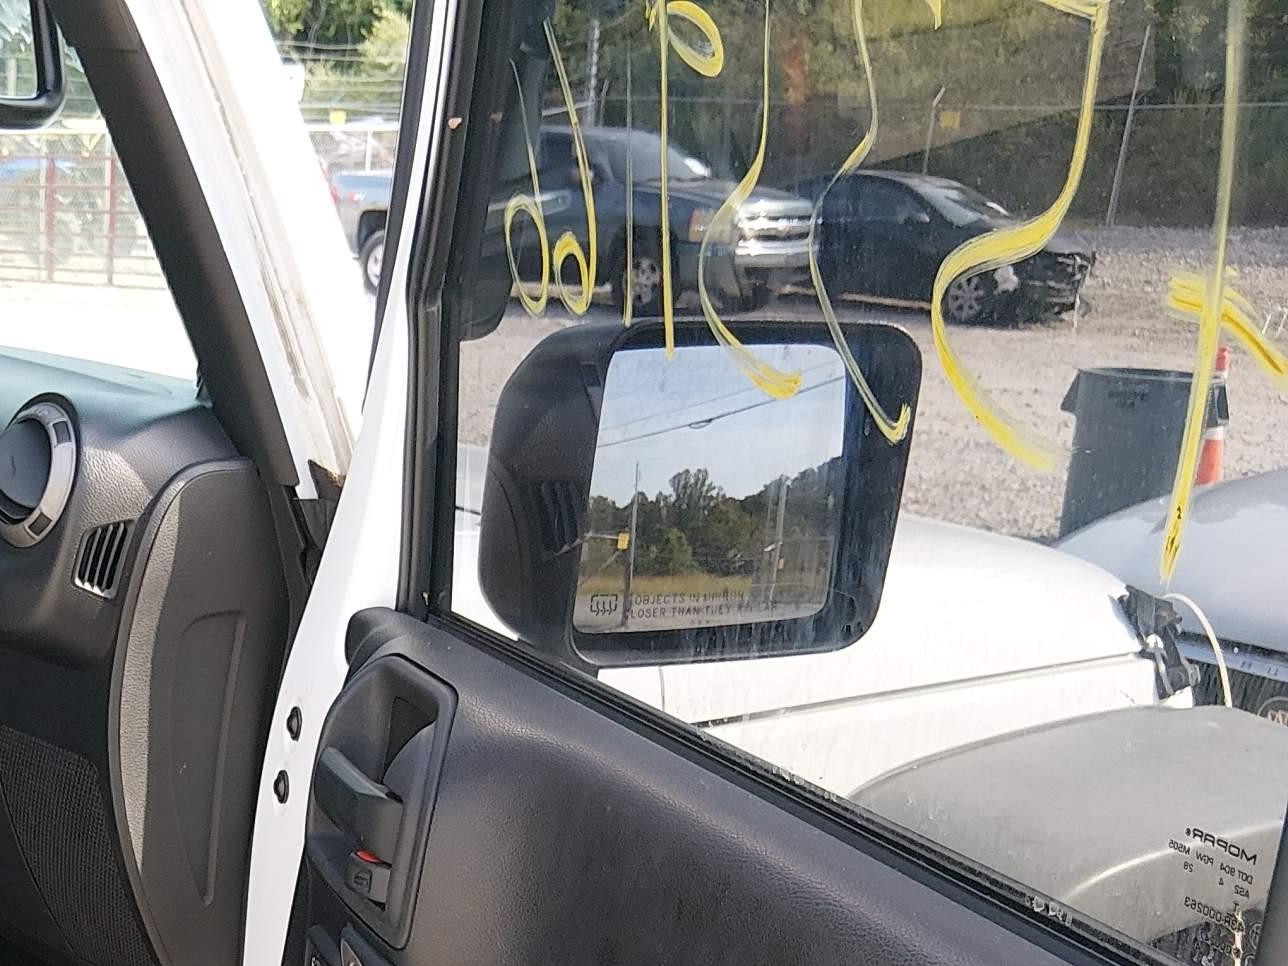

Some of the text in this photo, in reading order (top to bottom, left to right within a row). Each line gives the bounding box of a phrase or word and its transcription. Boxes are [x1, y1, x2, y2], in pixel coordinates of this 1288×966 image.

[635, 593, 686, 606] OBJECTS
[689, 593, 700, 602] IN
[672, 605, 700, 617] THAN
